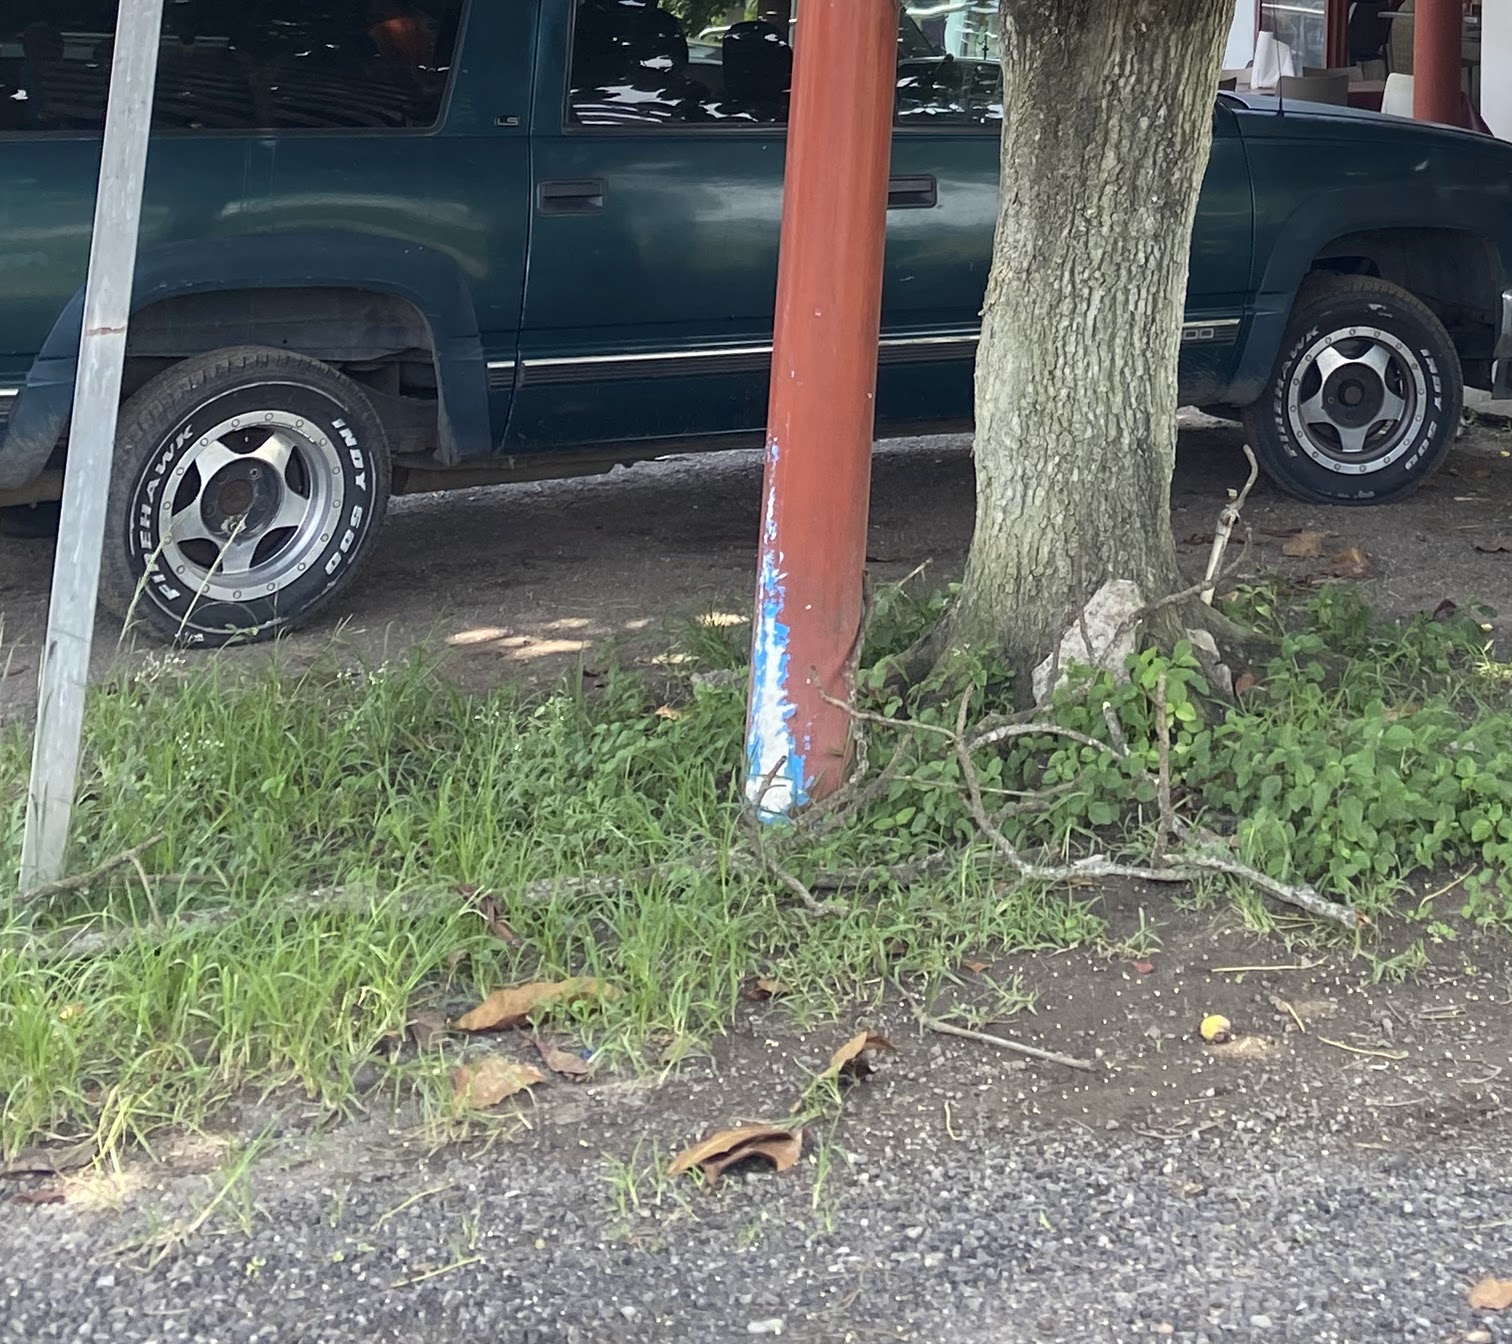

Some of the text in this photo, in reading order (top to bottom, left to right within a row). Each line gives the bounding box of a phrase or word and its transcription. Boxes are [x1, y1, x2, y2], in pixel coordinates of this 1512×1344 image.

[1420, 348, 1443, 413] INDY
[139, 424, 195, 600] FIREHAWK
[324, 418, 367, 575] INDY 500
